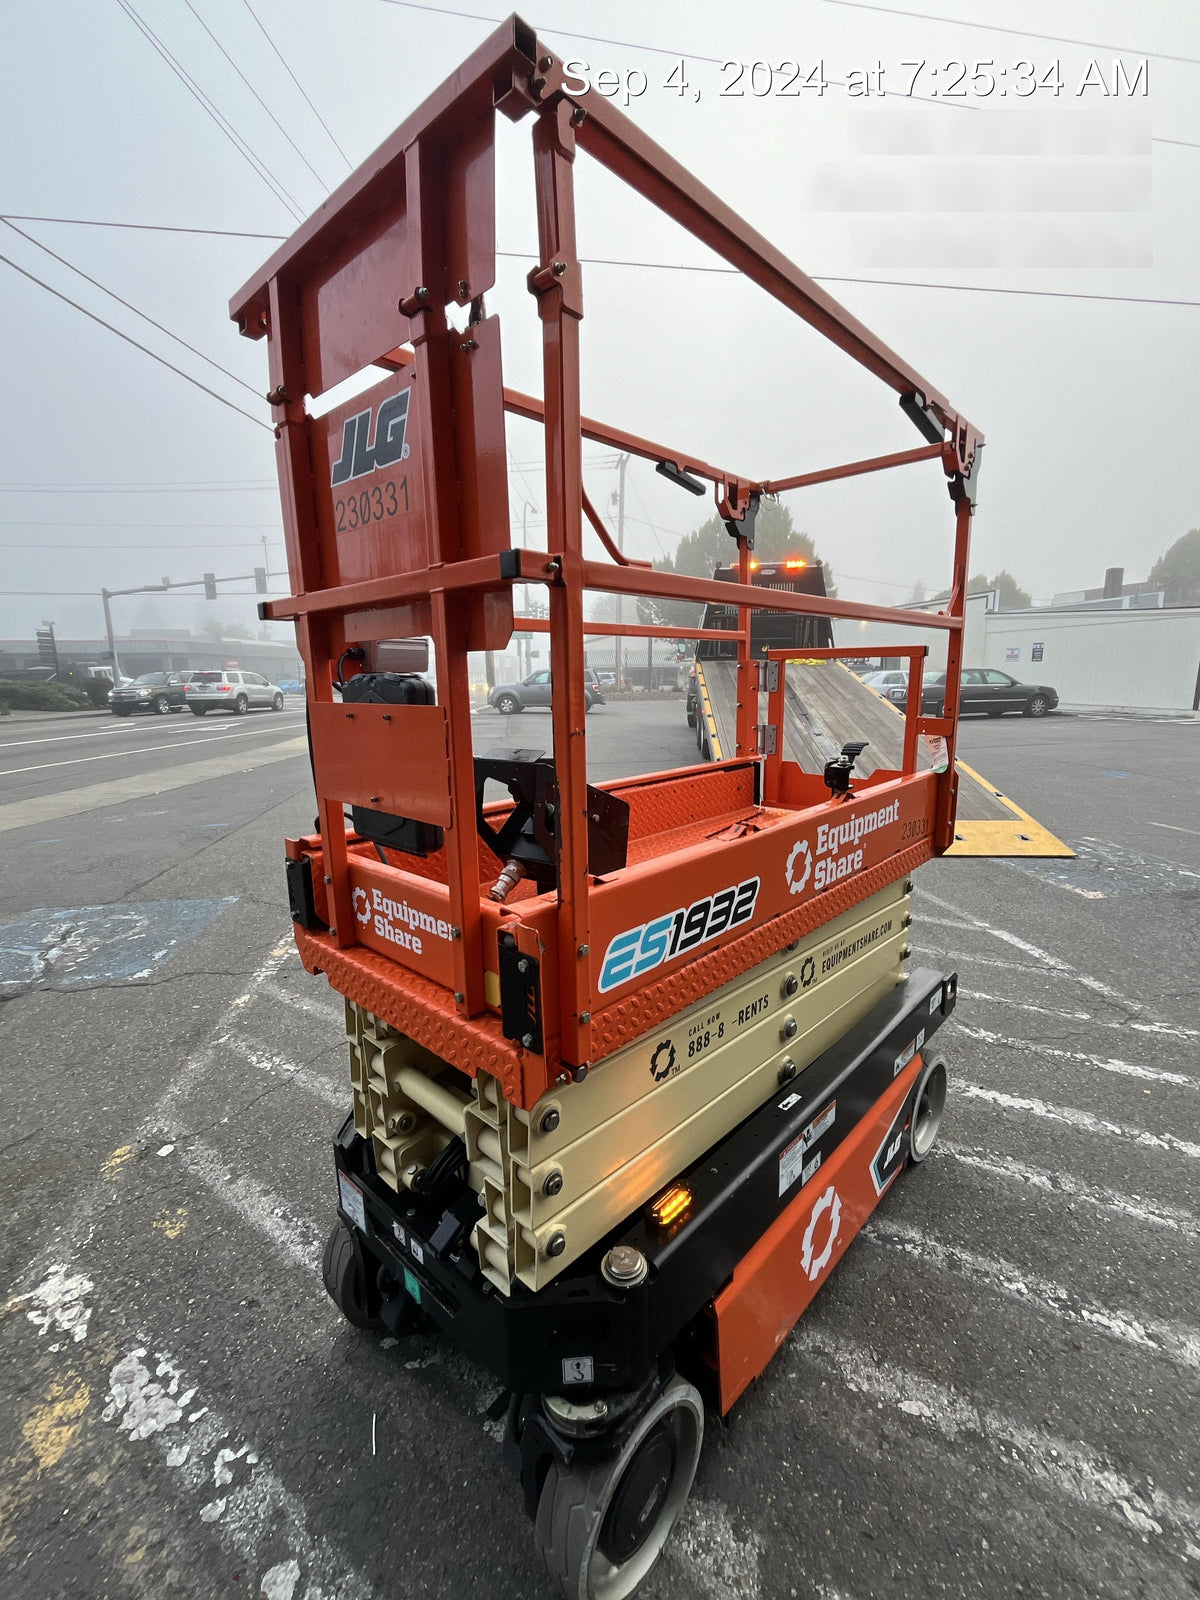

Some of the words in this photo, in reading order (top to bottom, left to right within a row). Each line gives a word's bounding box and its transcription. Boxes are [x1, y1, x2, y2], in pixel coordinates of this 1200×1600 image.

[331, 386, 411, 487] JLG
[336, 476, 409, 532] 230331
[816, 799, 899, 855] Equipment
[902, 817, 929, 840] 230331
[814, 849, 863, 890] Share
[371, 888, 453, 941] Equipme
[374, 914, 422, 955] Share
[598, 875, 760, 993] ES1932
[822, 920, 893, 974] EQUIPMENTSHARE.COM
[688, 1023, 704, 1037] CALL
[707, 1012, 721, 1026] NOW
